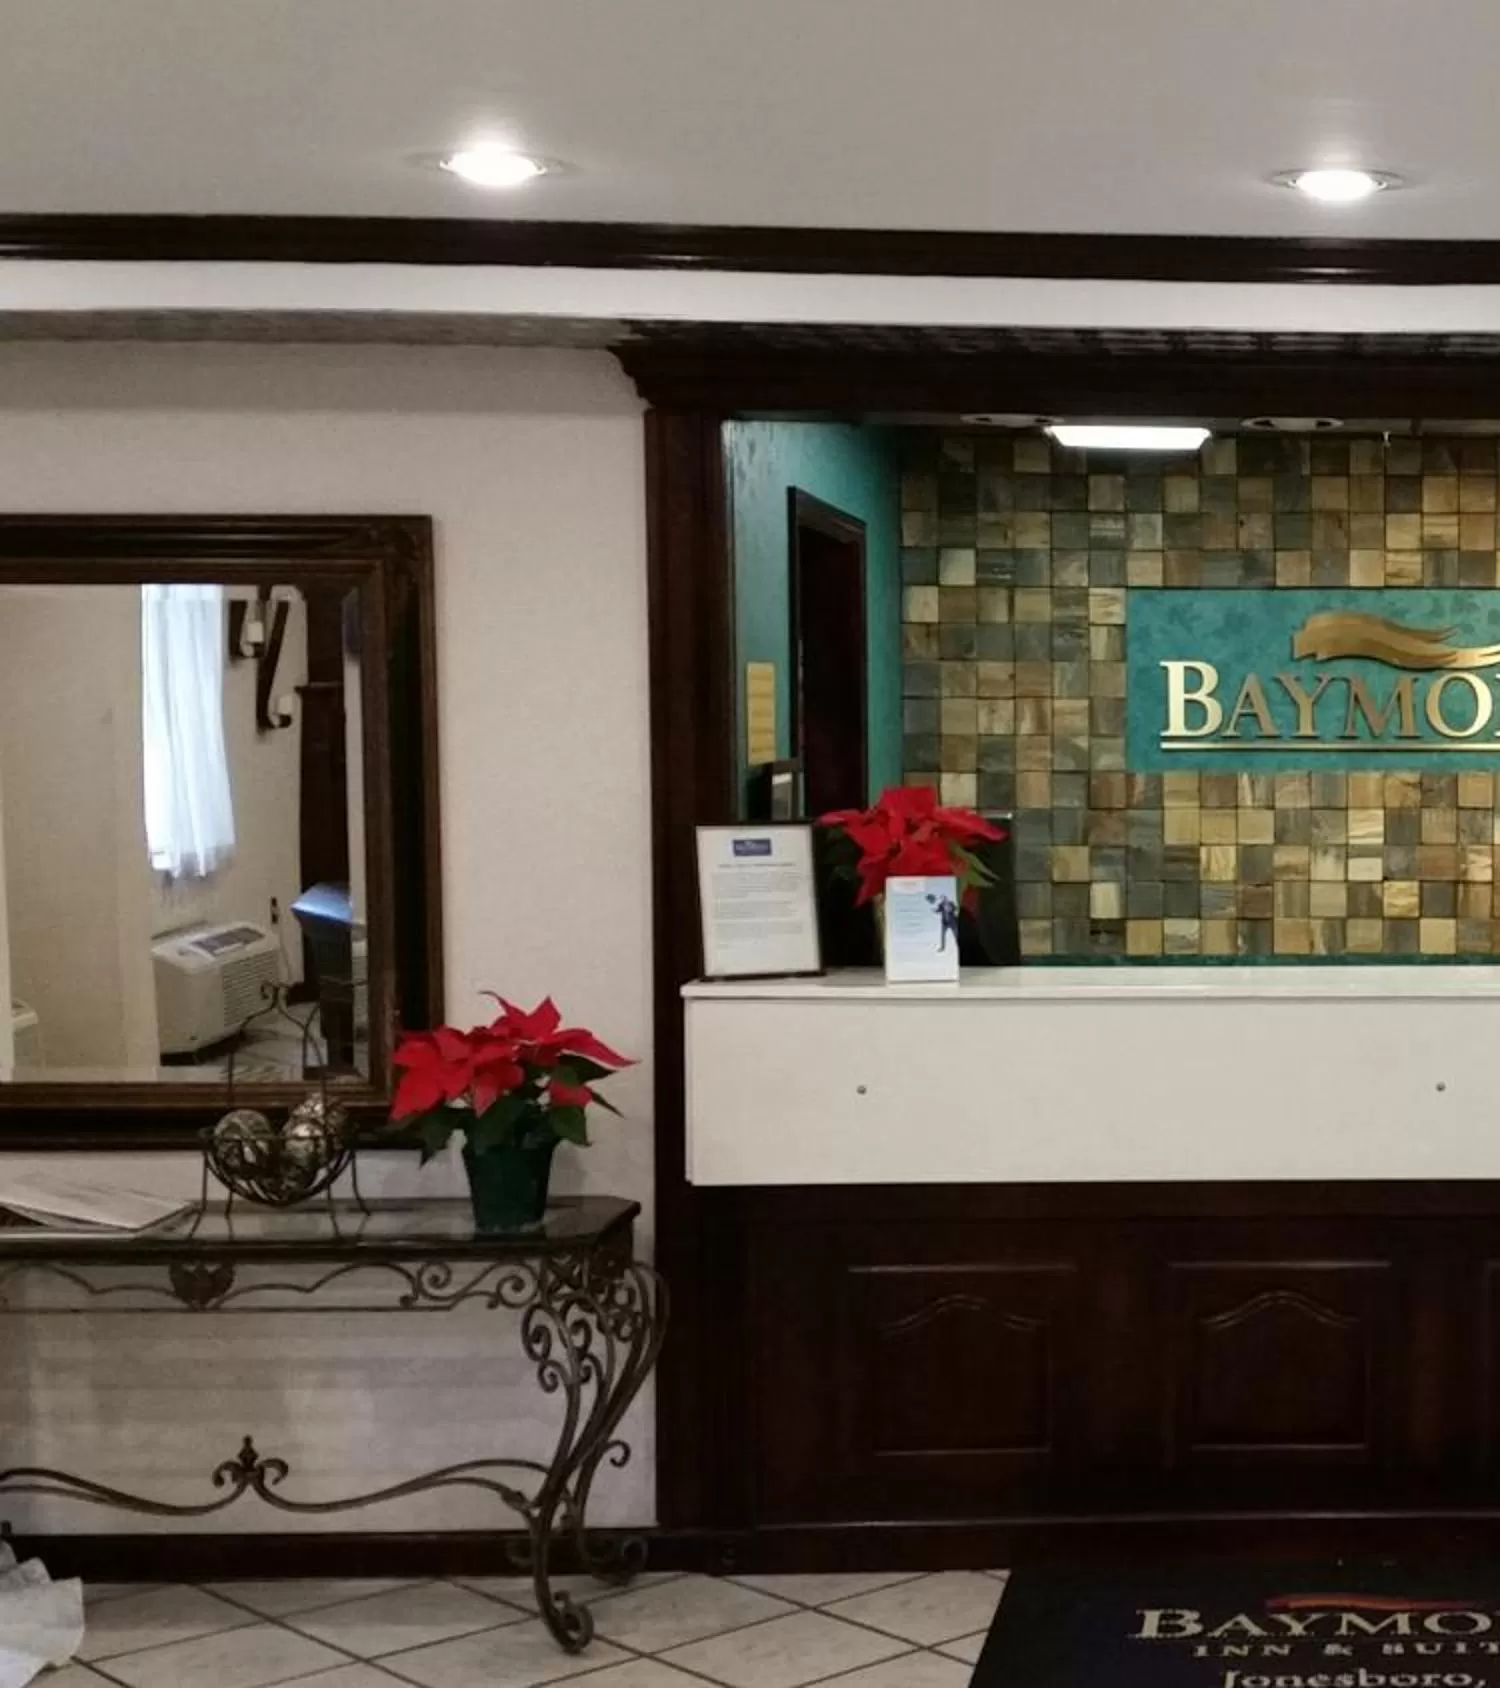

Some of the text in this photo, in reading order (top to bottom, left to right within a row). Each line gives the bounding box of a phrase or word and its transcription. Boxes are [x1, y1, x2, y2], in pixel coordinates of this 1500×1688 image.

[1194, 1643, 1292, 1657] INN
[1324, 1643, 1354, 1656] &
[1218, 1668, 1487, 1688] Jonesboro,
